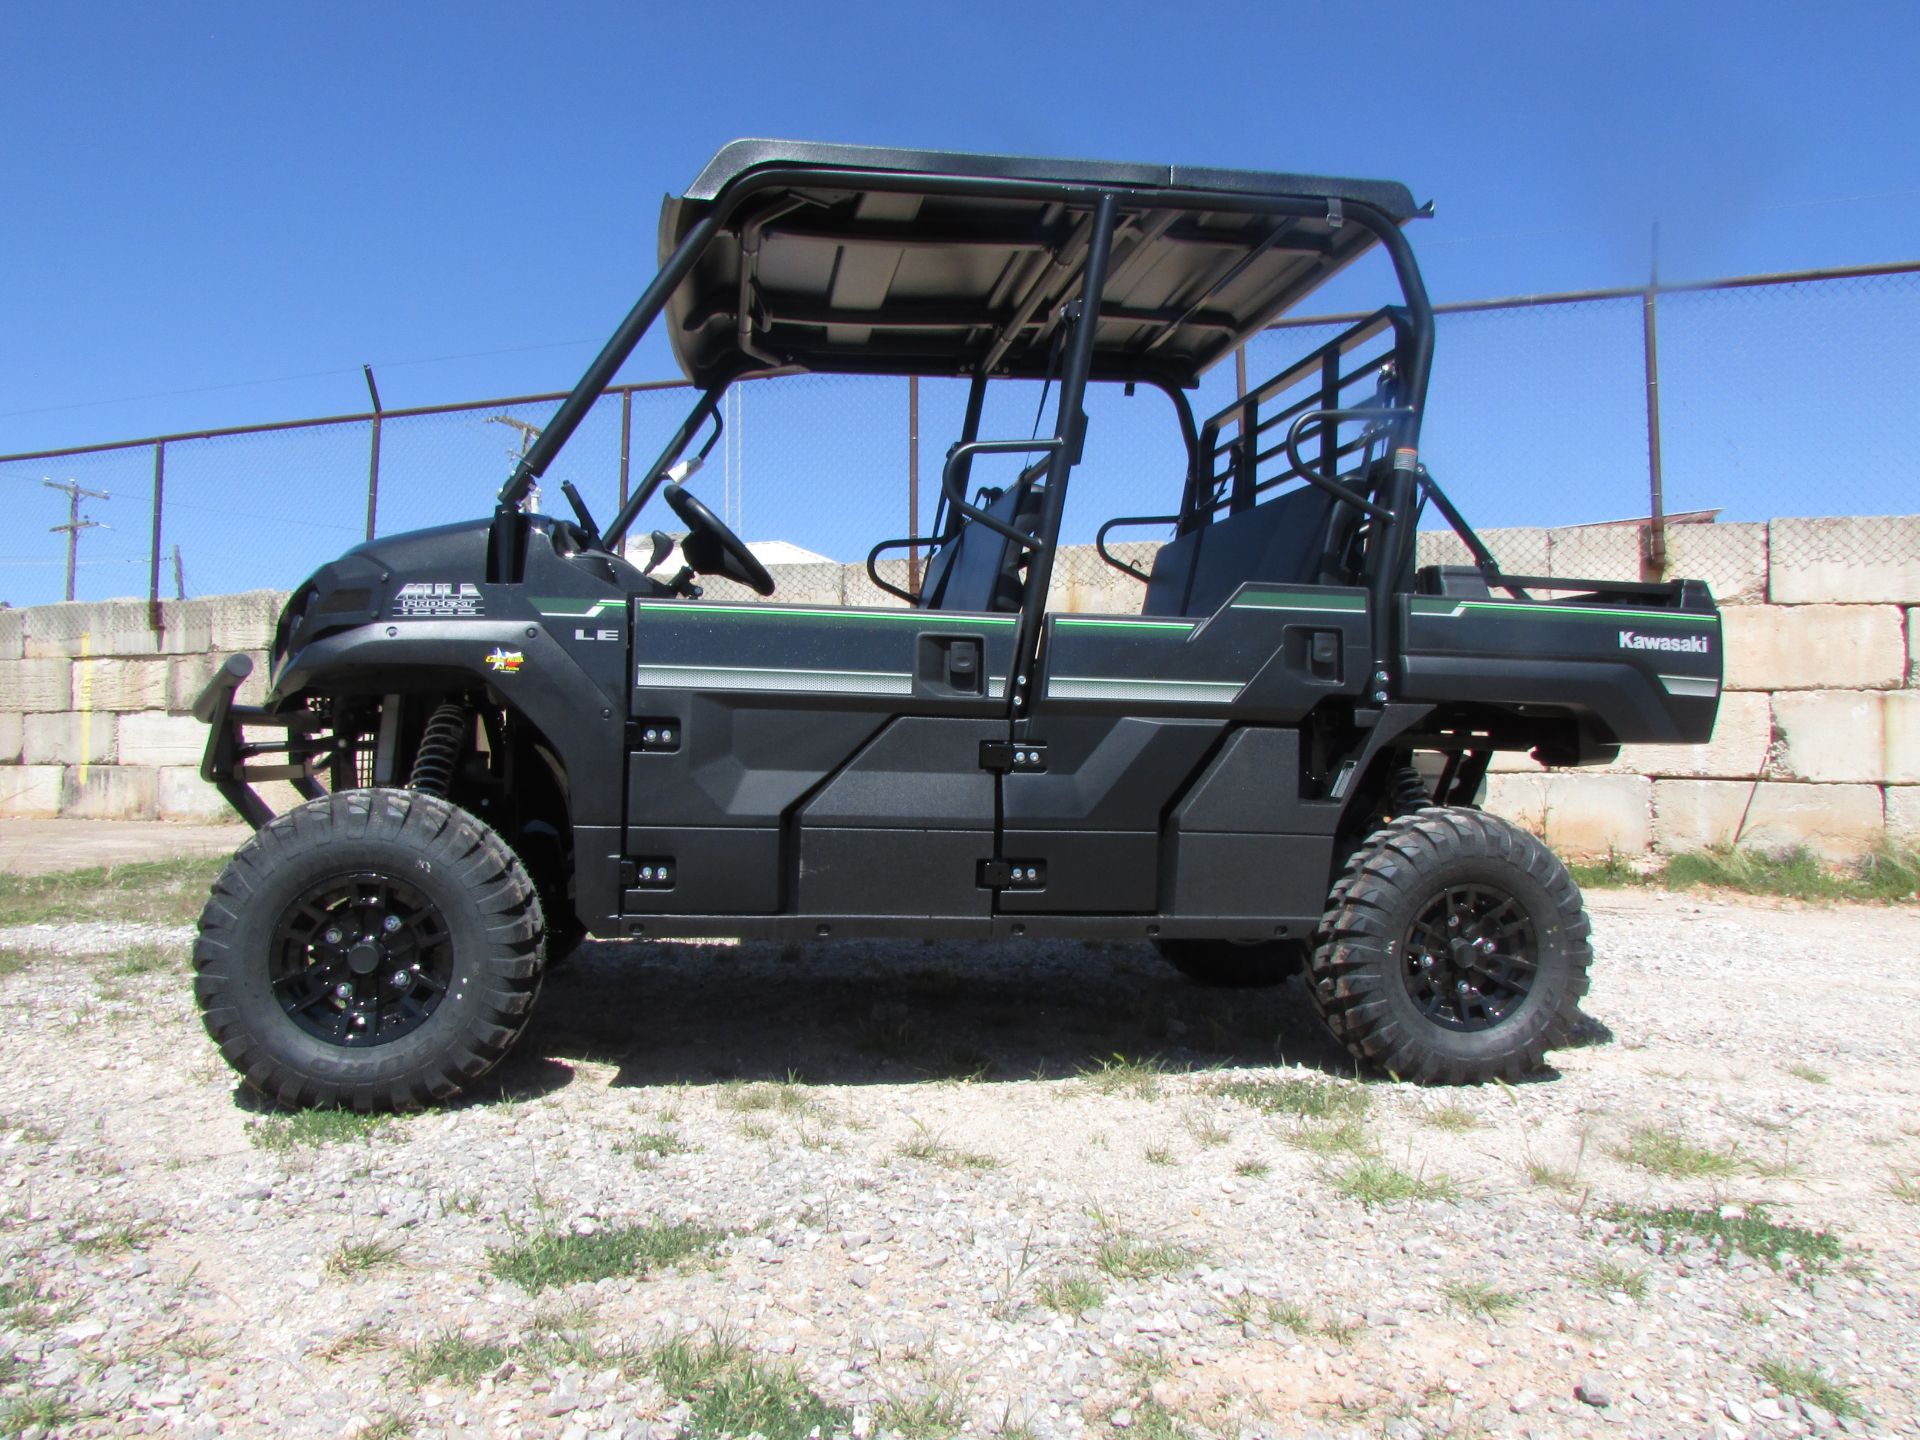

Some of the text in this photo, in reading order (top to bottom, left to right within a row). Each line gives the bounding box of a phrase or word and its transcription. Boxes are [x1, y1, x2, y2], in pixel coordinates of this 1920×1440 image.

[394, 583, 484, 601] MULE
[574, 629, 619, 641] LE
[1618, 630, 1709, 654] Kawasaki
